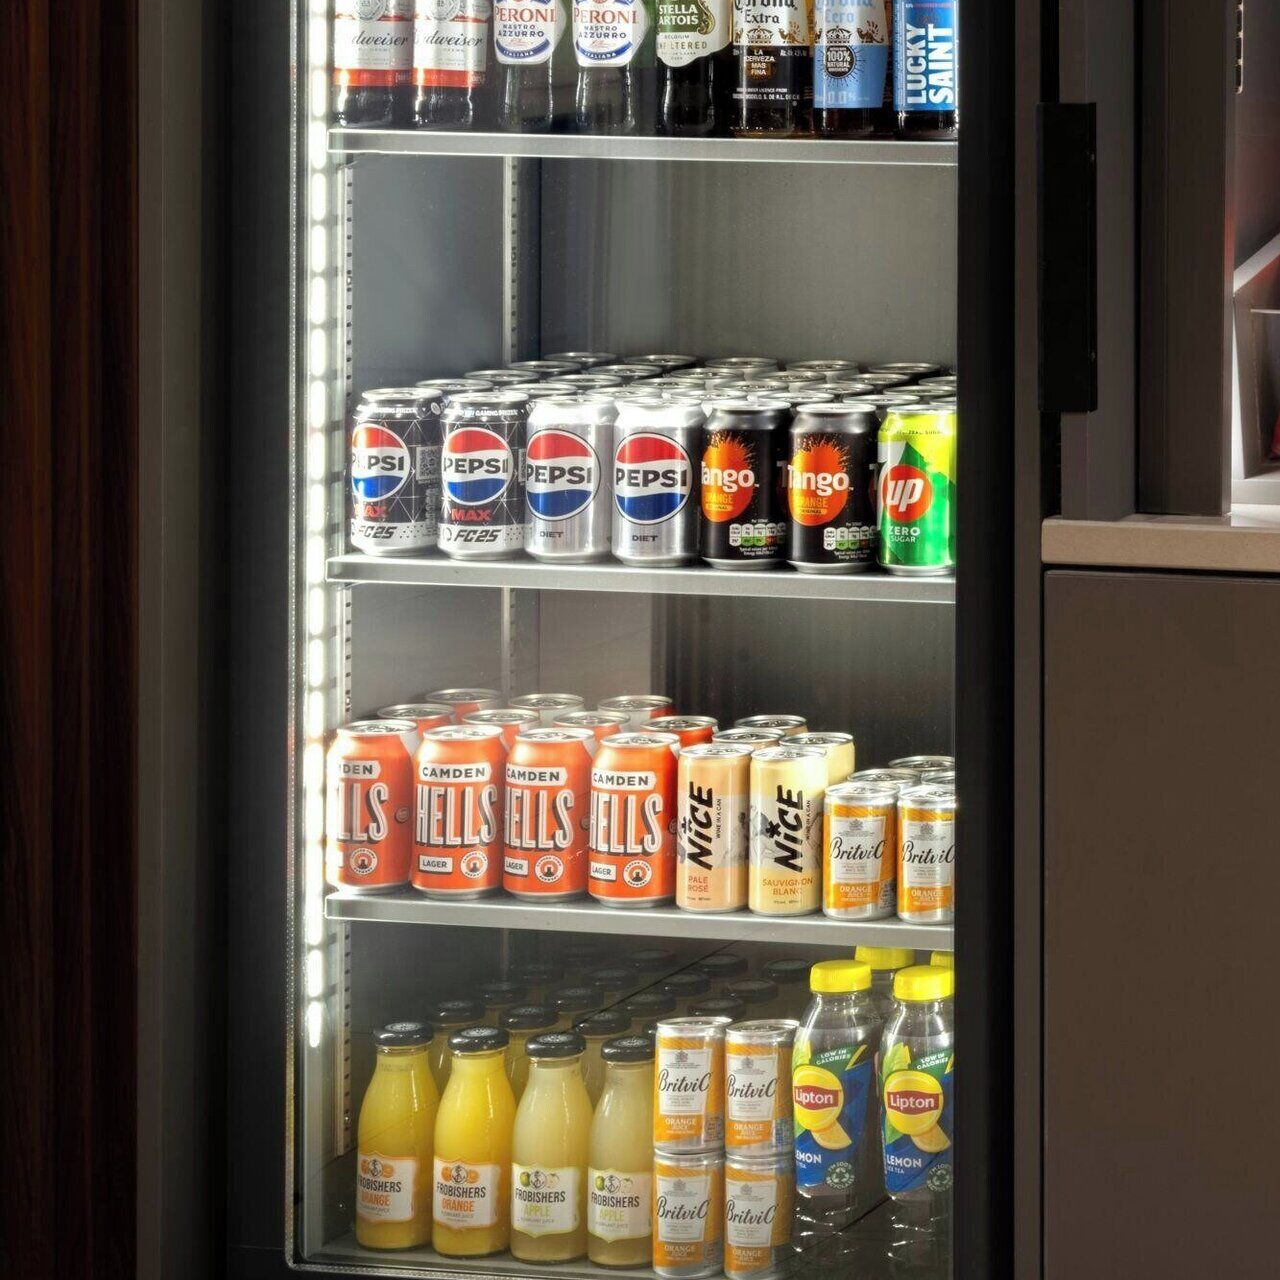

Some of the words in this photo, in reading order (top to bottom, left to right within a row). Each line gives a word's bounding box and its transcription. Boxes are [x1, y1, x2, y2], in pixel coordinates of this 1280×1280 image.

[495, 7, 557, 22] PERONI
[574, 7, 637, 24] PERONI
[659, 4, 697, 15] STELLA
[745, 9, 779, 23] Extra
[659, 14, 698, 25] ARTOIS
[827, 51, 850, 62] 100%
[906, 23, 927, 104] LUCKY
[929, 24, 954, 104] SAINT
[444, 458, 508, 473] PEPSI
[527, 465, 592, 484] PEPSI
[616, 469, 687, 487] PEPSI
[702, 462, 755, 492] Tango
[788, 465, 849, 496] Tango
[887, 478, 924, 512] up
[451, 508, 492, 520] MAX
[888, 527, 920, 536] ZERO
[422, 766, 486, 779] CAMDEN
[506, 768, 560, 782] CAMDEN
[593, 772, 649, 787] CAMDEN
[416, 785, 497, 846] HELLS
[505, 788, 574, 849] HELLS
[590, 791, 663, 854] HELLS
[423, 860, 447, 870] LAGER
[506, 861, 524, 871] LAGER
[592, 866, 612, 876] LAGER
[762, 877, 813, 886] SAUVIGNON
[840, 885, 873, 894] ORANGE
[796, 1091, 833, 1105] Lipton
[890, 1095, 934, 1110] Lipton
[887, 1154, 921, 1167] LEMON
[436, 1184, 486, 1198] FROBISHERS
[515, 1188, 566, 1202] FROBISHERS
[441, 1198, 475, 1212] ORANGE
[591, 1192, 640, 1207] FROBISHERS
